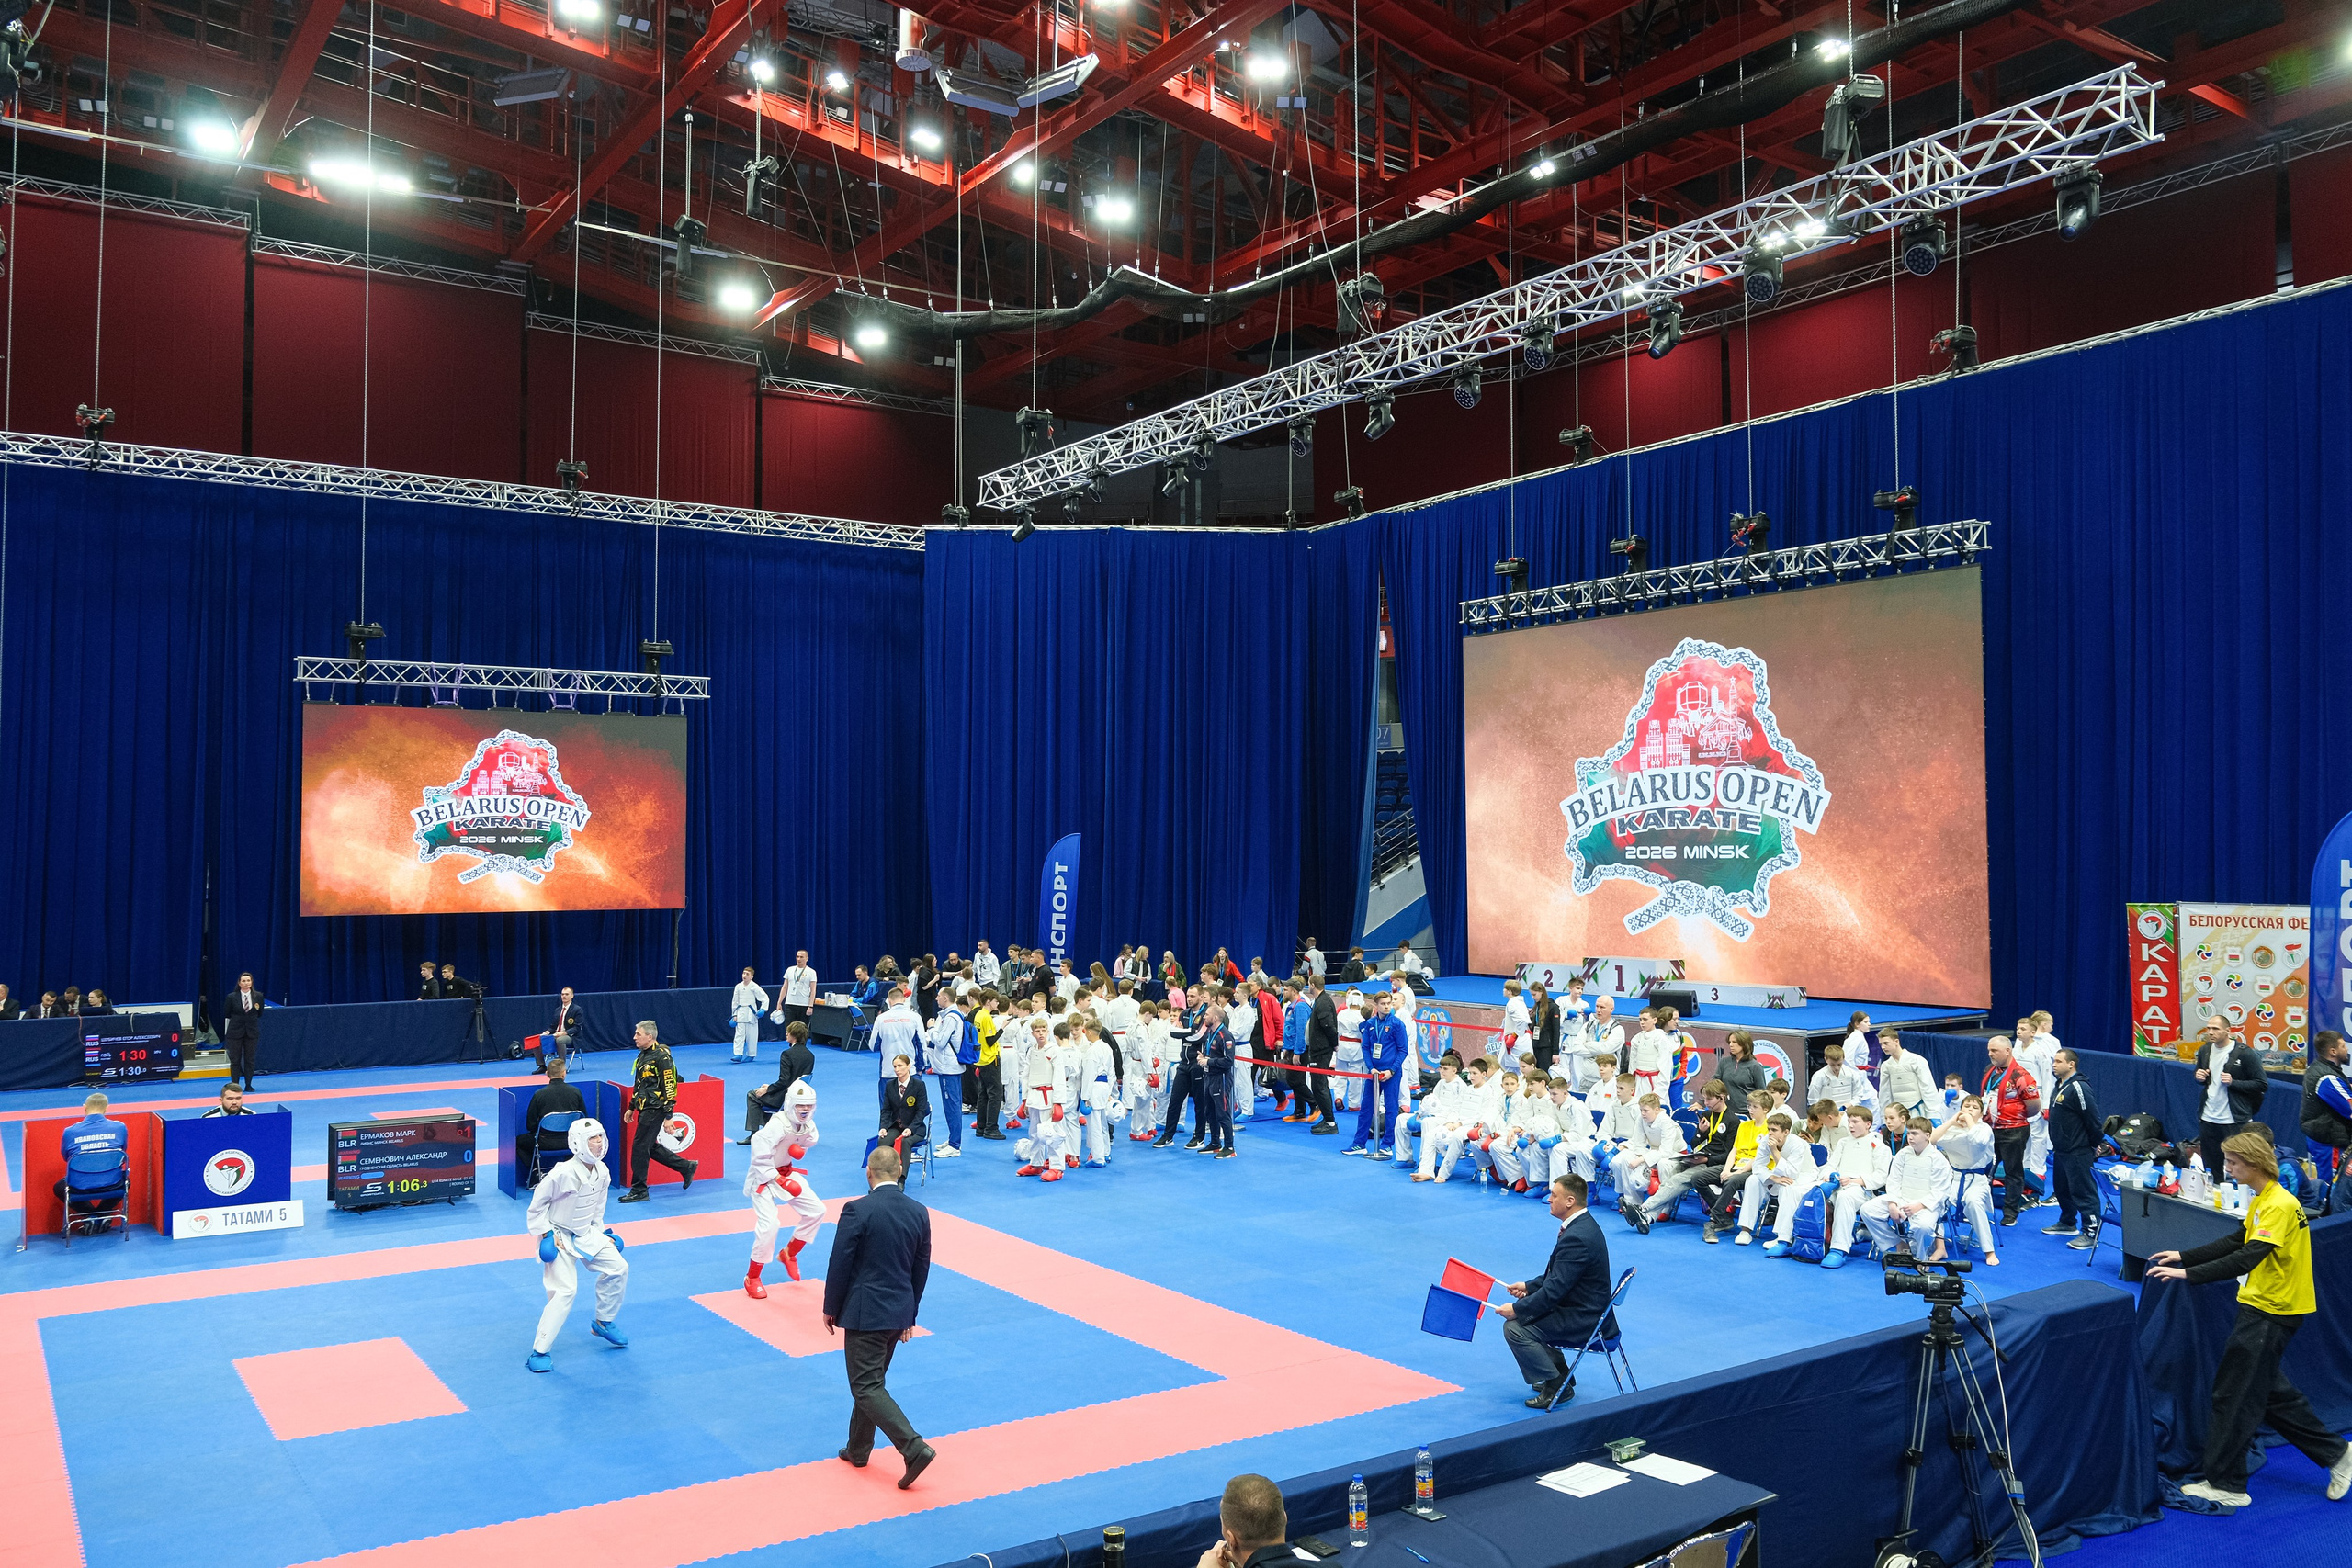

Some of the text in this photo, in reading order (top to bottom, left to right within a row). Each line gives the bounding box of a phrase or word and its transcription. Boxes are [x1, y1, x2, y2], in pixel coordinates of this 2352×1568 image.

[1566, 770, 1824, 829] BELARUS OPEN
[415, 796, 587, 828] BELARUS OPEN
[454, 817, 551, 831] KARATE
[1617, 807, 1762, 837] KARATE
[459, 836, 544, 844] 2026 MINSK
[1624, 844, 1750, 860] 2026 MINSK
[2189, 915, 2284, 930] БЕЛОРУССКАЯ
[1544, 969, 1554, 987] 2
[1614, 964, 1625, 992] 1
[1711, 987, 1719, 1001] 3
[171, 1033, 179, 1043] 0
[171, 1048, 178, 1057] 0
[74, 1133, 116, 1145] ИВАНОВСКАЯ
[360, 1129, 416, 1140] ЕРМАКОВ МАРК
[80, 1141, 110, 1151] ОБЛАСТЬ
[338, 1139, 356, 1148] BLR
[359, 1151, 447, 1166] СЕМЕНОВИЧ АЛЕКСАНДР
[463, 1149, 473, 1163] 0
[337, 1165, 356, 1173] BLR
[222, 1207, 288, 1227] ТАТАМИ 5
